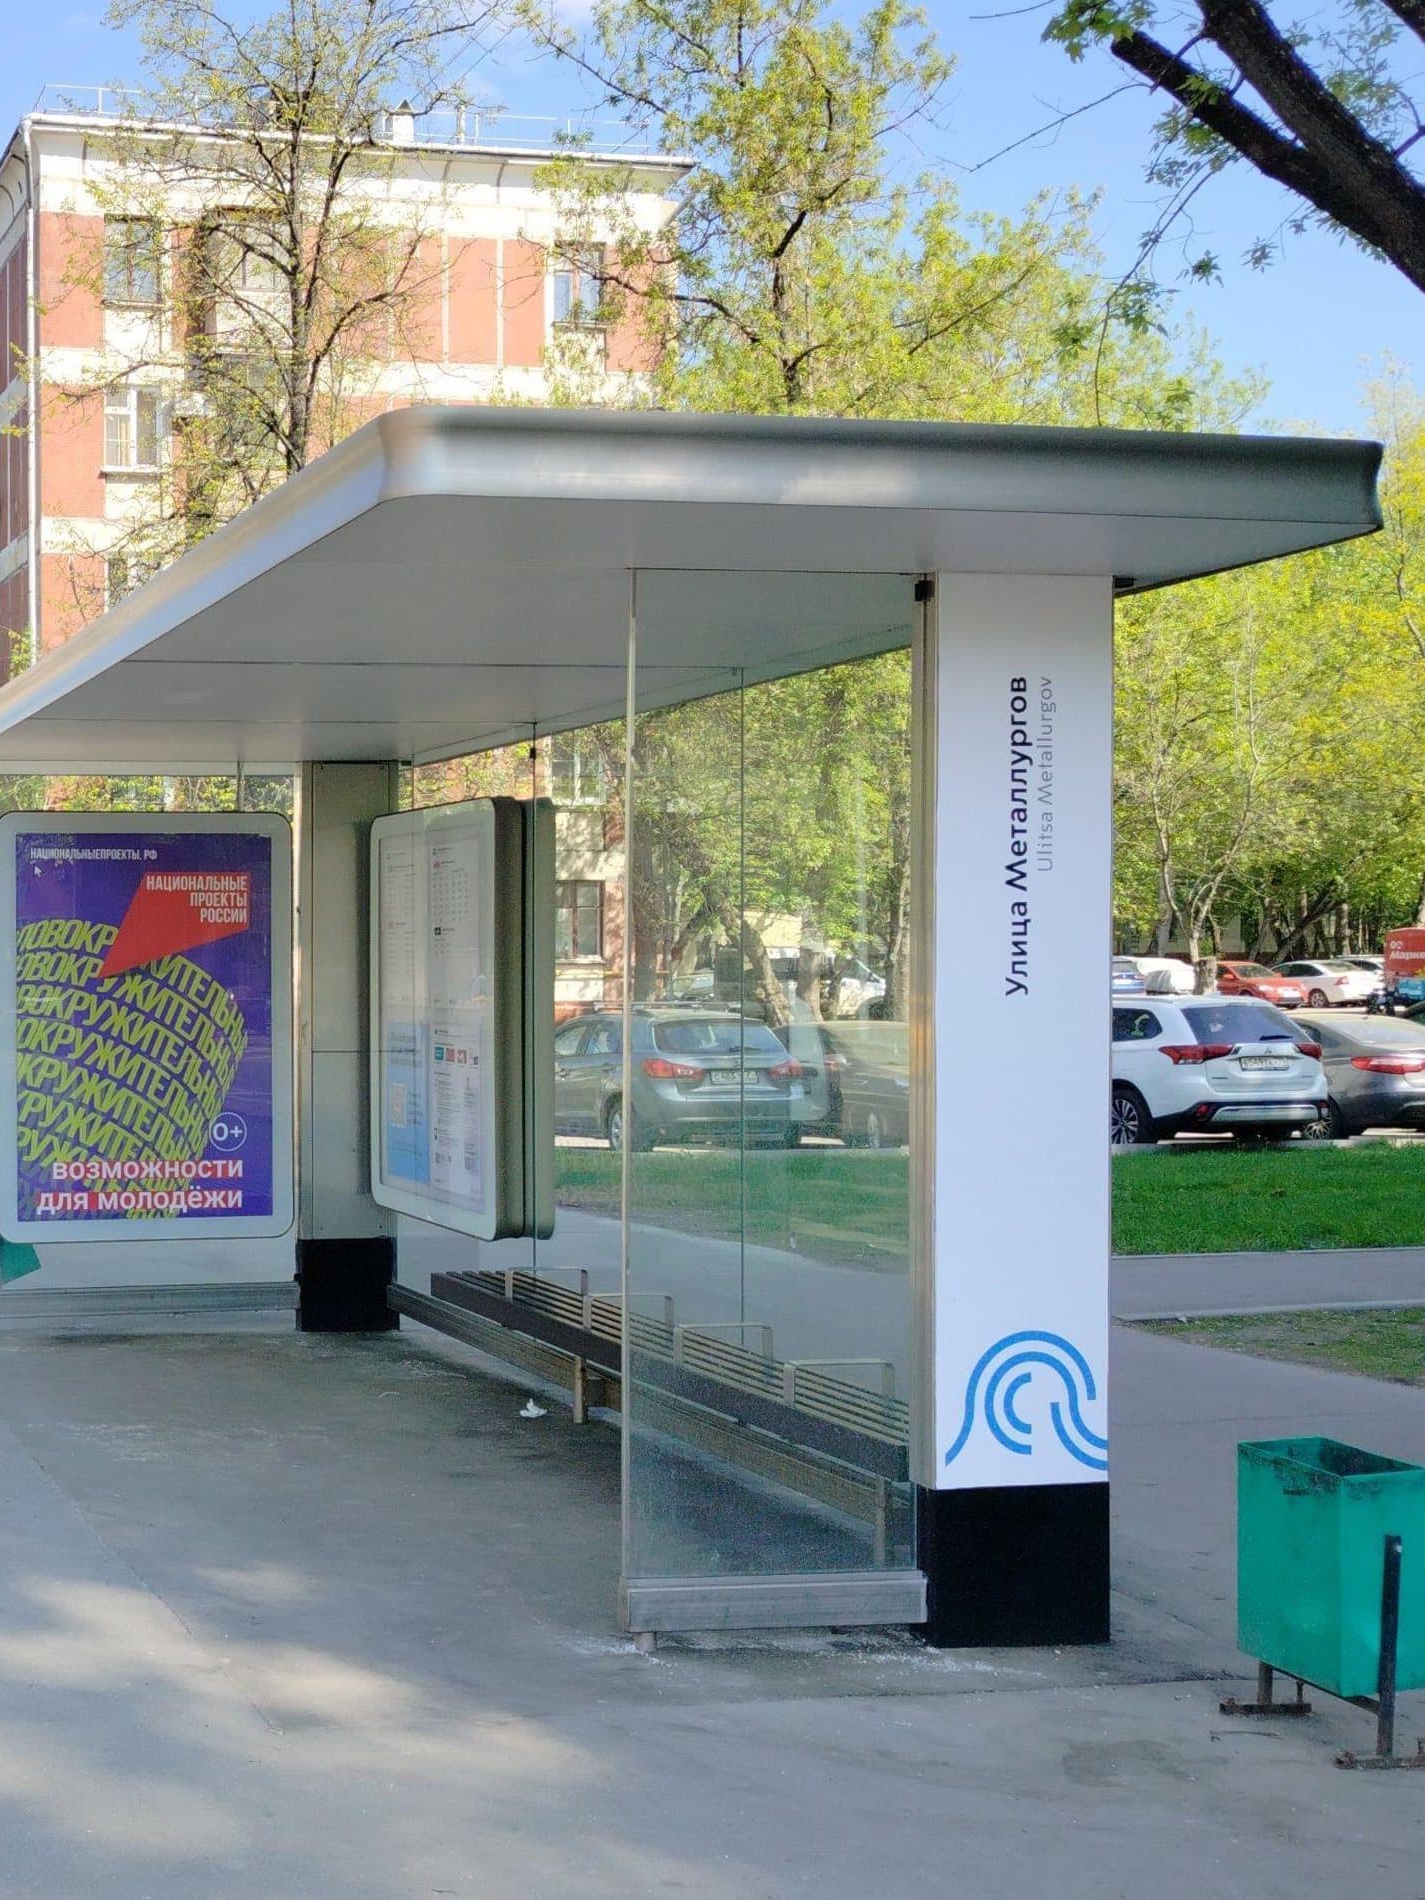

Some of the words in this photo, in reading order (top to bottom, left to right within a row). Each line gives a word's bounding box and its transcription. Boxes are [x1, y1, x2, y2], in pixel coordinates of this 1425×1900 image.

[1037, 676, 1057, 804] Metallurgov
[1005, 676, 1033, 893] Металлургов
[1037, 811, 1054, 872] Ulitsa
[146, 875, 248, 892] НАЦИОНАЛЬНЫЕ
[190, 892, 248, 907] ПРОЕКТЫ
[200, 907, 248, 923] РОССИИ
[1005, 902, 1031, 996] Улица
[212, 1122, 243, 1142] 0+
[36, 1191, 88, 1215] для
[98, 1185, 243, 1212] молодёжи
